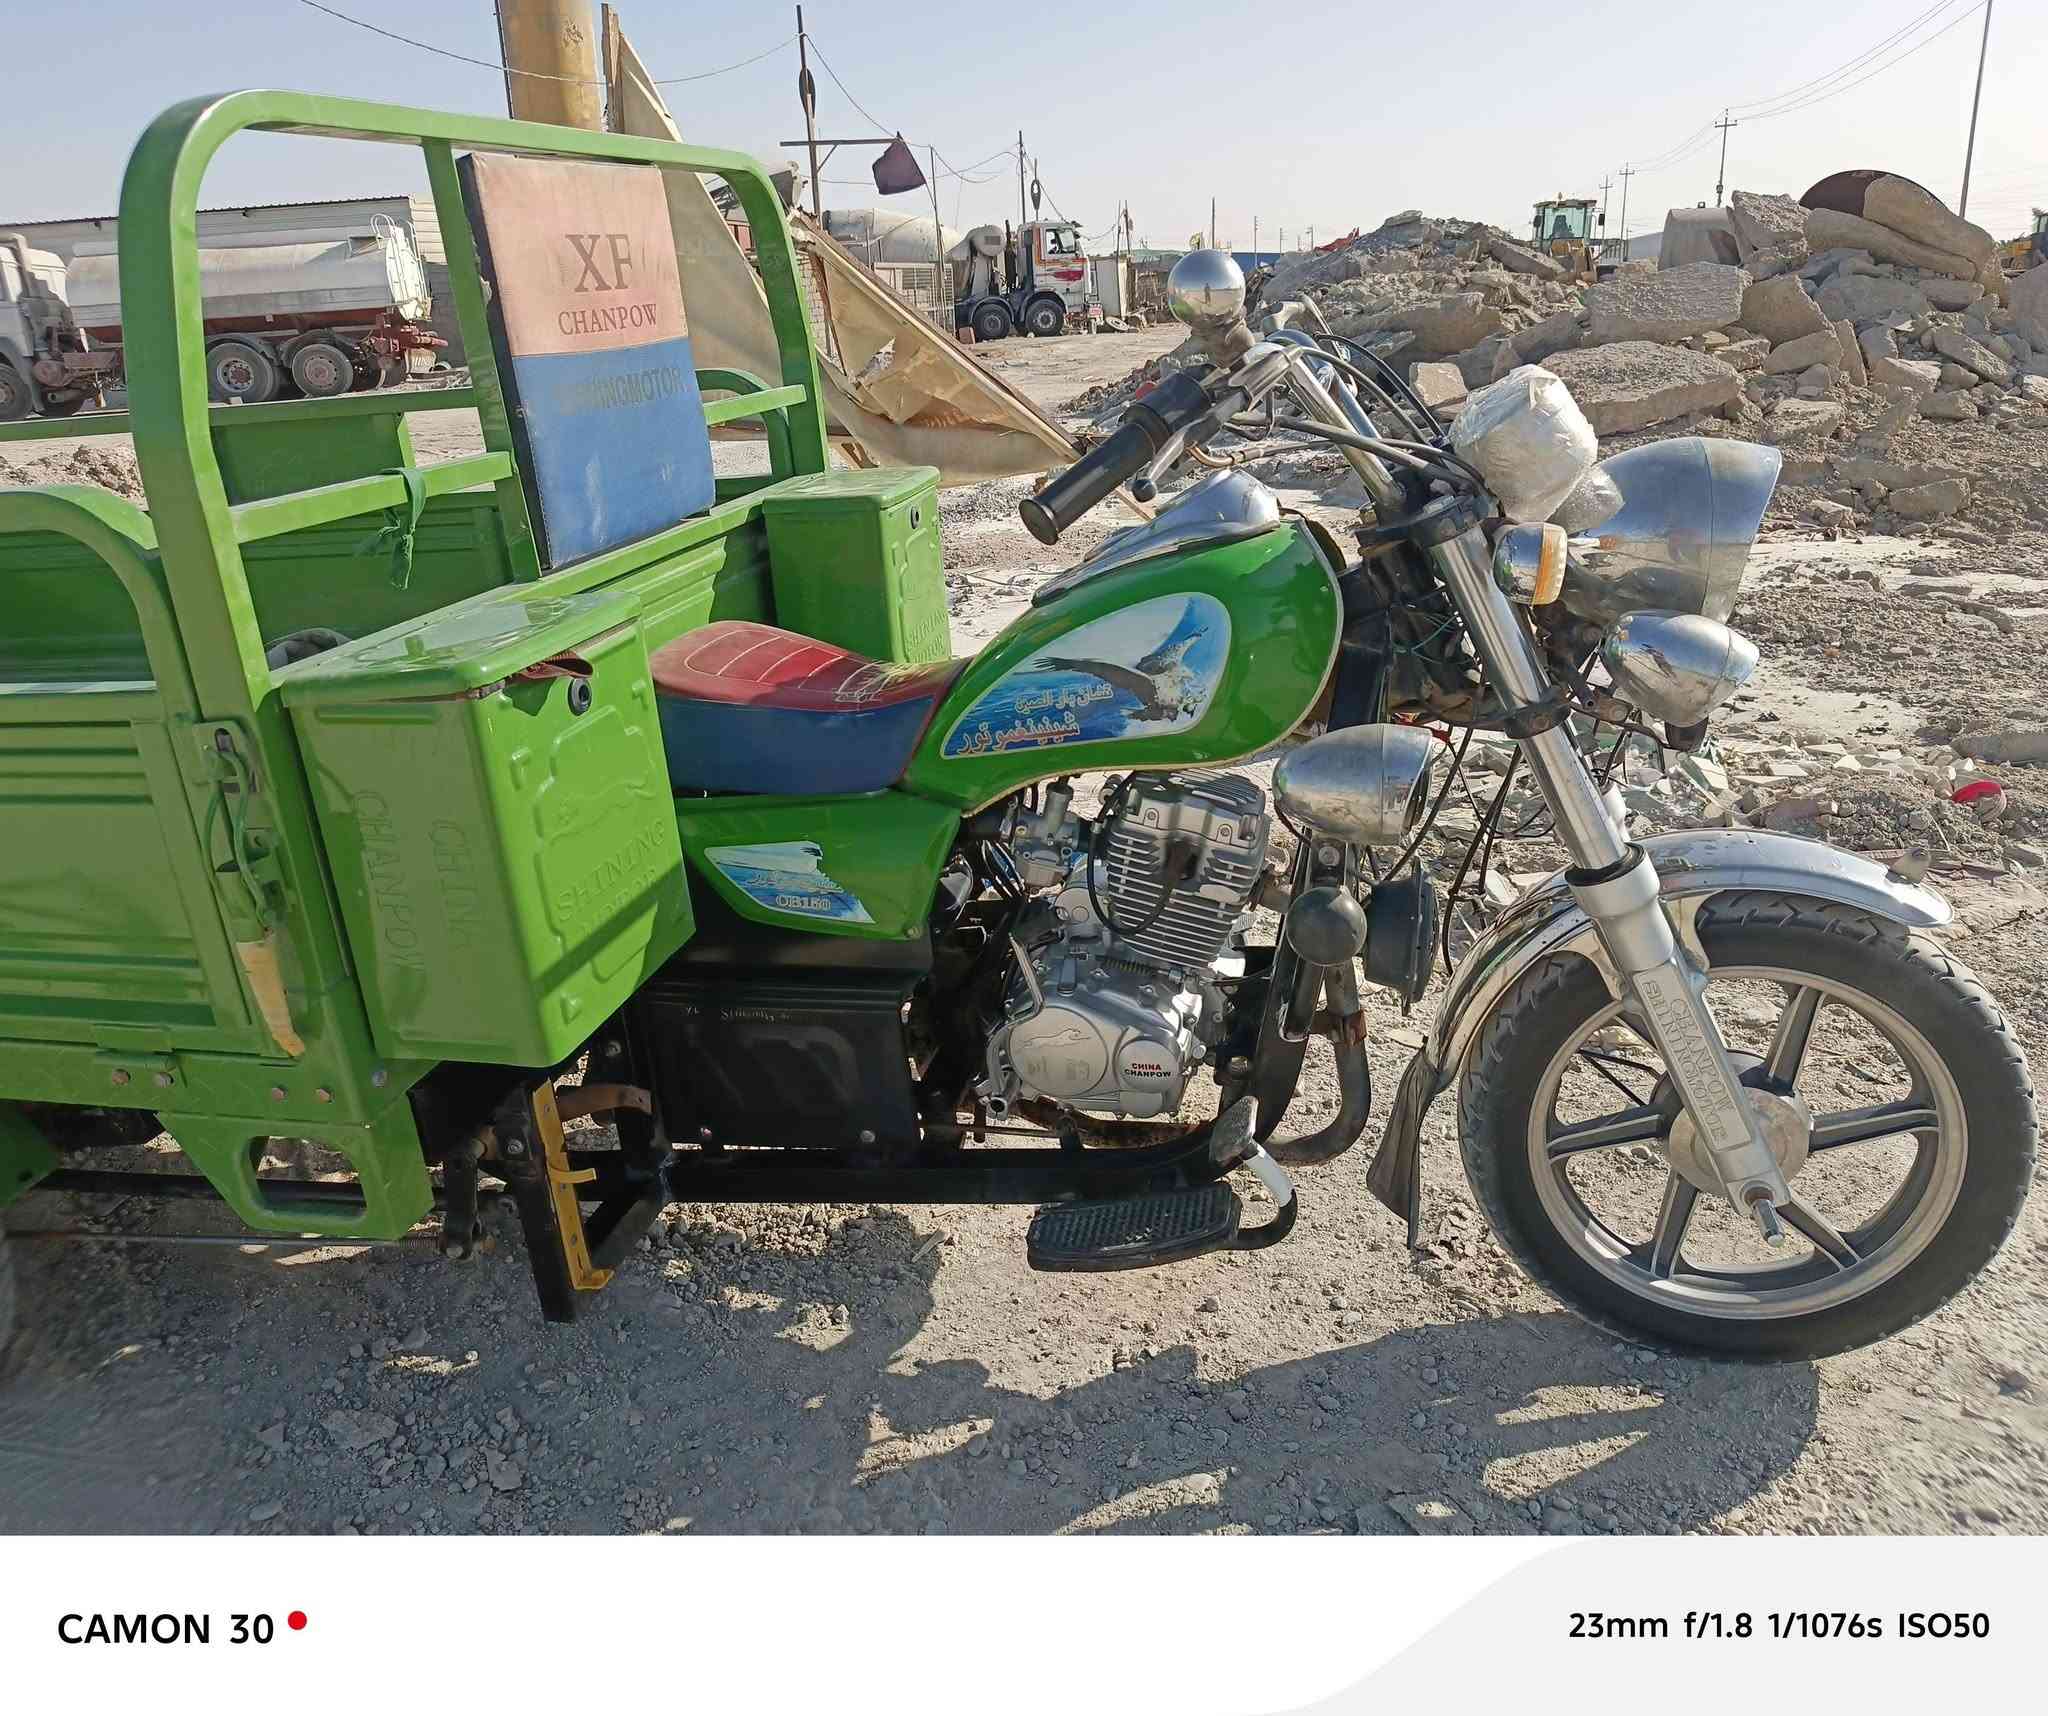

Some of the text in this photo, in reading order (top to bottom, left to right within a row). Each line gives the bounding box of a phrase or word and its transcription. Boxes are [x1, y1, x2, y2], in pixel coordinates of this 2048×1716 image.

[565, 233, 633, 293] XF
[558, 303, 657, 336] CHANPOW
[1124, 1068, 1171, 1078] CHANPOW
[1131, 1062, 1162, 1071] CHINA
